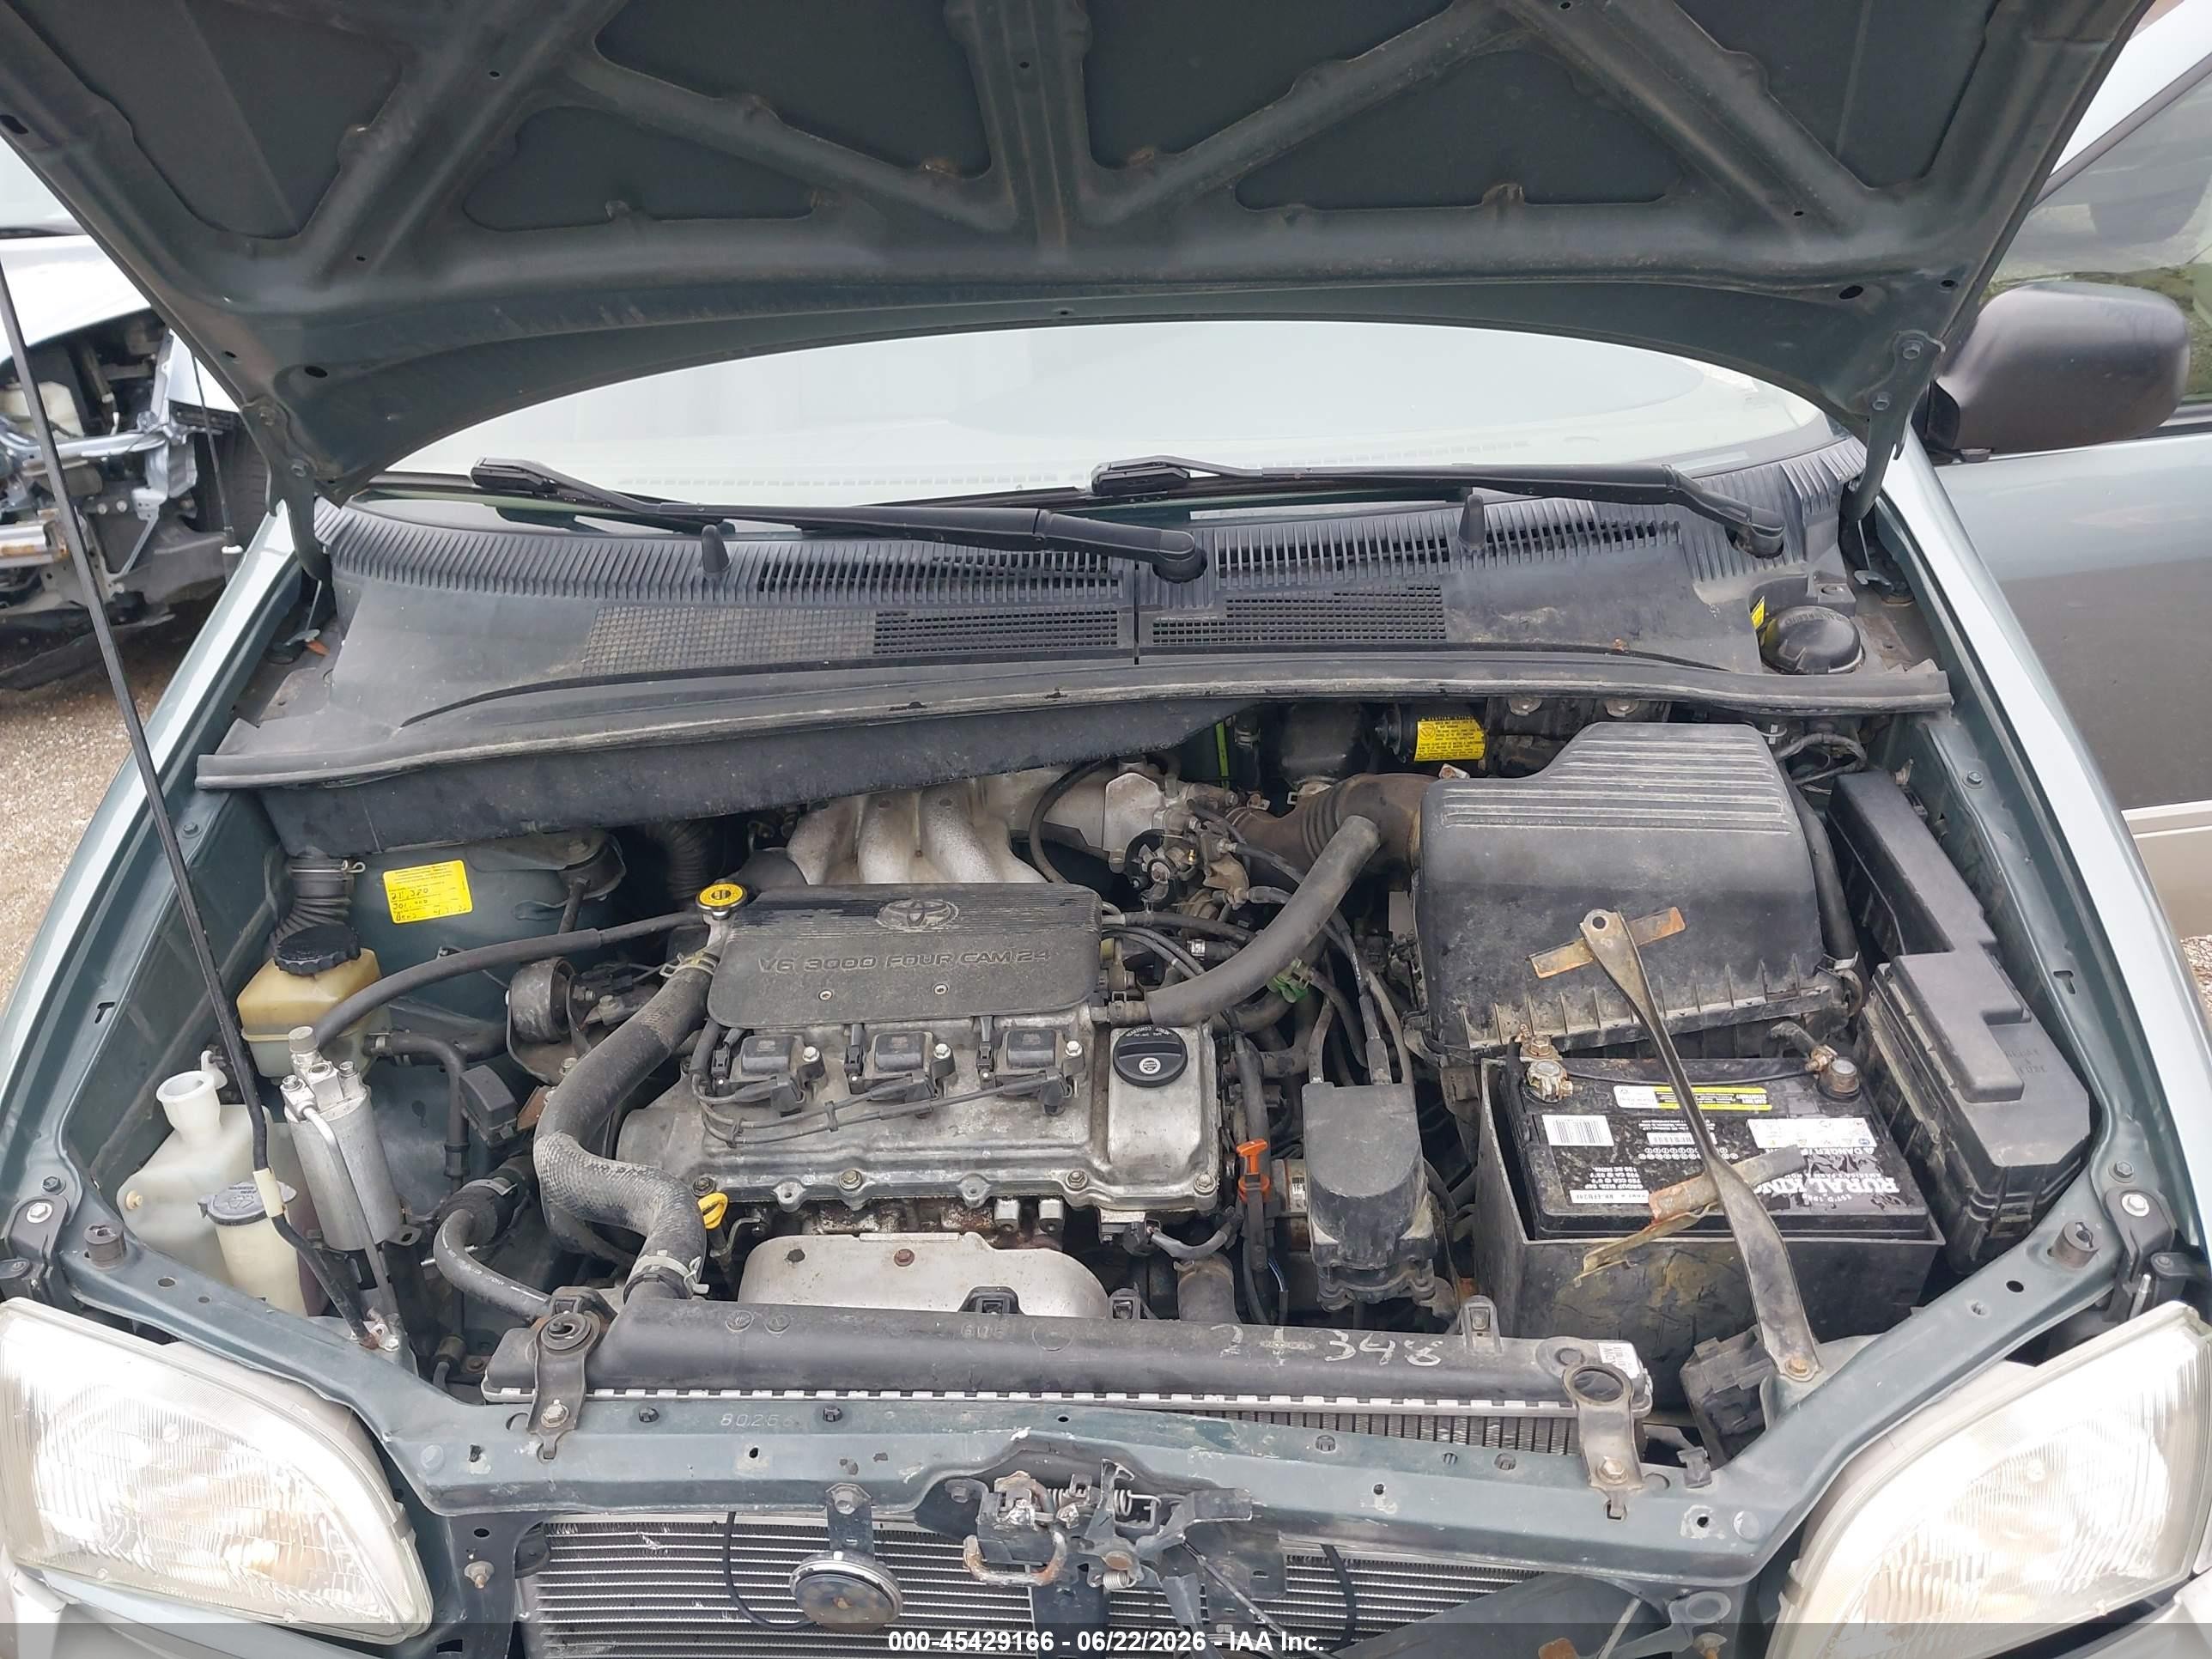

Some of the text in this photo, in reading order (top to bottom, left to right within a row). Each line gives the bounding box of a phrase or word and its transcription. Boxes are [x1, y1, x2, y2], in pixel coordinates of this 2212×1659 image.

[759, 948, 1051, 974] V6 3000 FOUR CAM 24
[1807, 1177, 1900, 1195] RURAL
